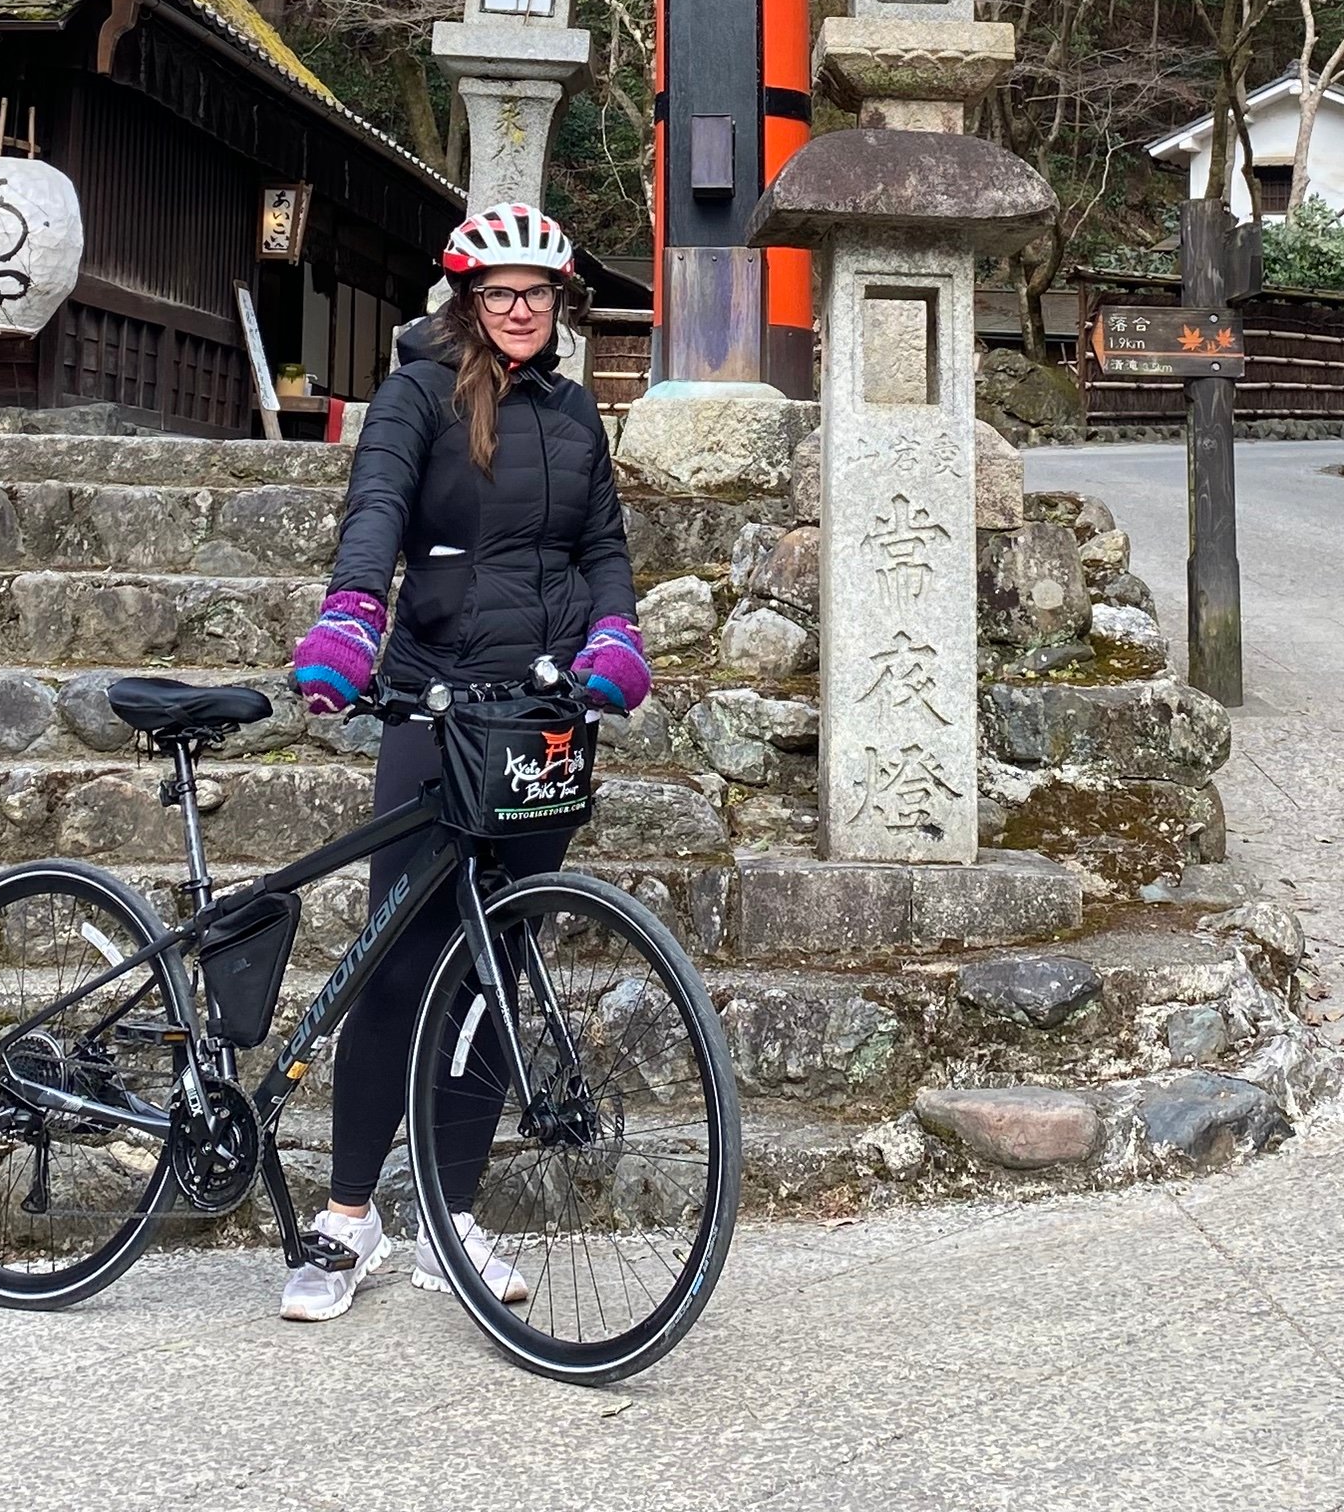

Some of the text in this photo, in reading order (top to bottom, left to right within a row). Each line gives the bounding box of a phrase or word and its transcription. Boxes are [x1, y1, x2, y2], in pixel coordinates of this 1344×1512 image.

[1108, 313, 1151, 332] 落合
[1109, 337, 1145, 349] 1.9km
[846, 493, 963, 840] 常夜燈
[504, 747, 542, 792] Kyoto
[523, 775, 579, 804] Bike Tour
[277, 872, 411, 1073] cannondale
